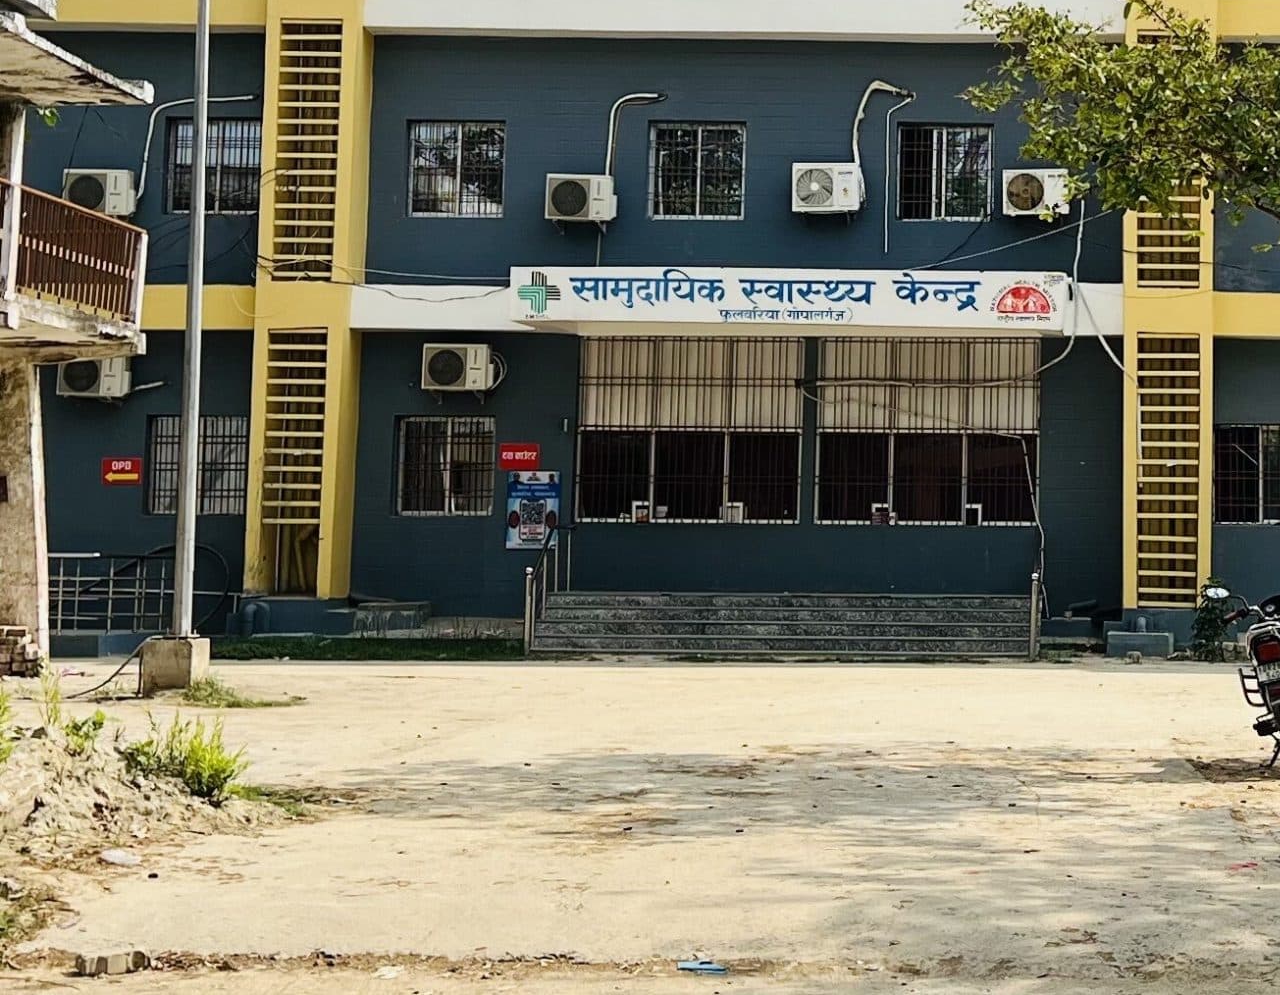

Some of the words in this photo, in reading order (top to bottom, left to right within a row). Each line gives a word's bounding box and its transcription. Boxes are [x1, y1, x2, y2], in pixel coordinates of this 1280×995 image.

[569, 269, 725, 308] सामुदायिक
[738, 279, 876, 304] स्वास्थ्य
[892, 272, 981, 311] केन्द्र
[111, 460, 132, 471] OPD
